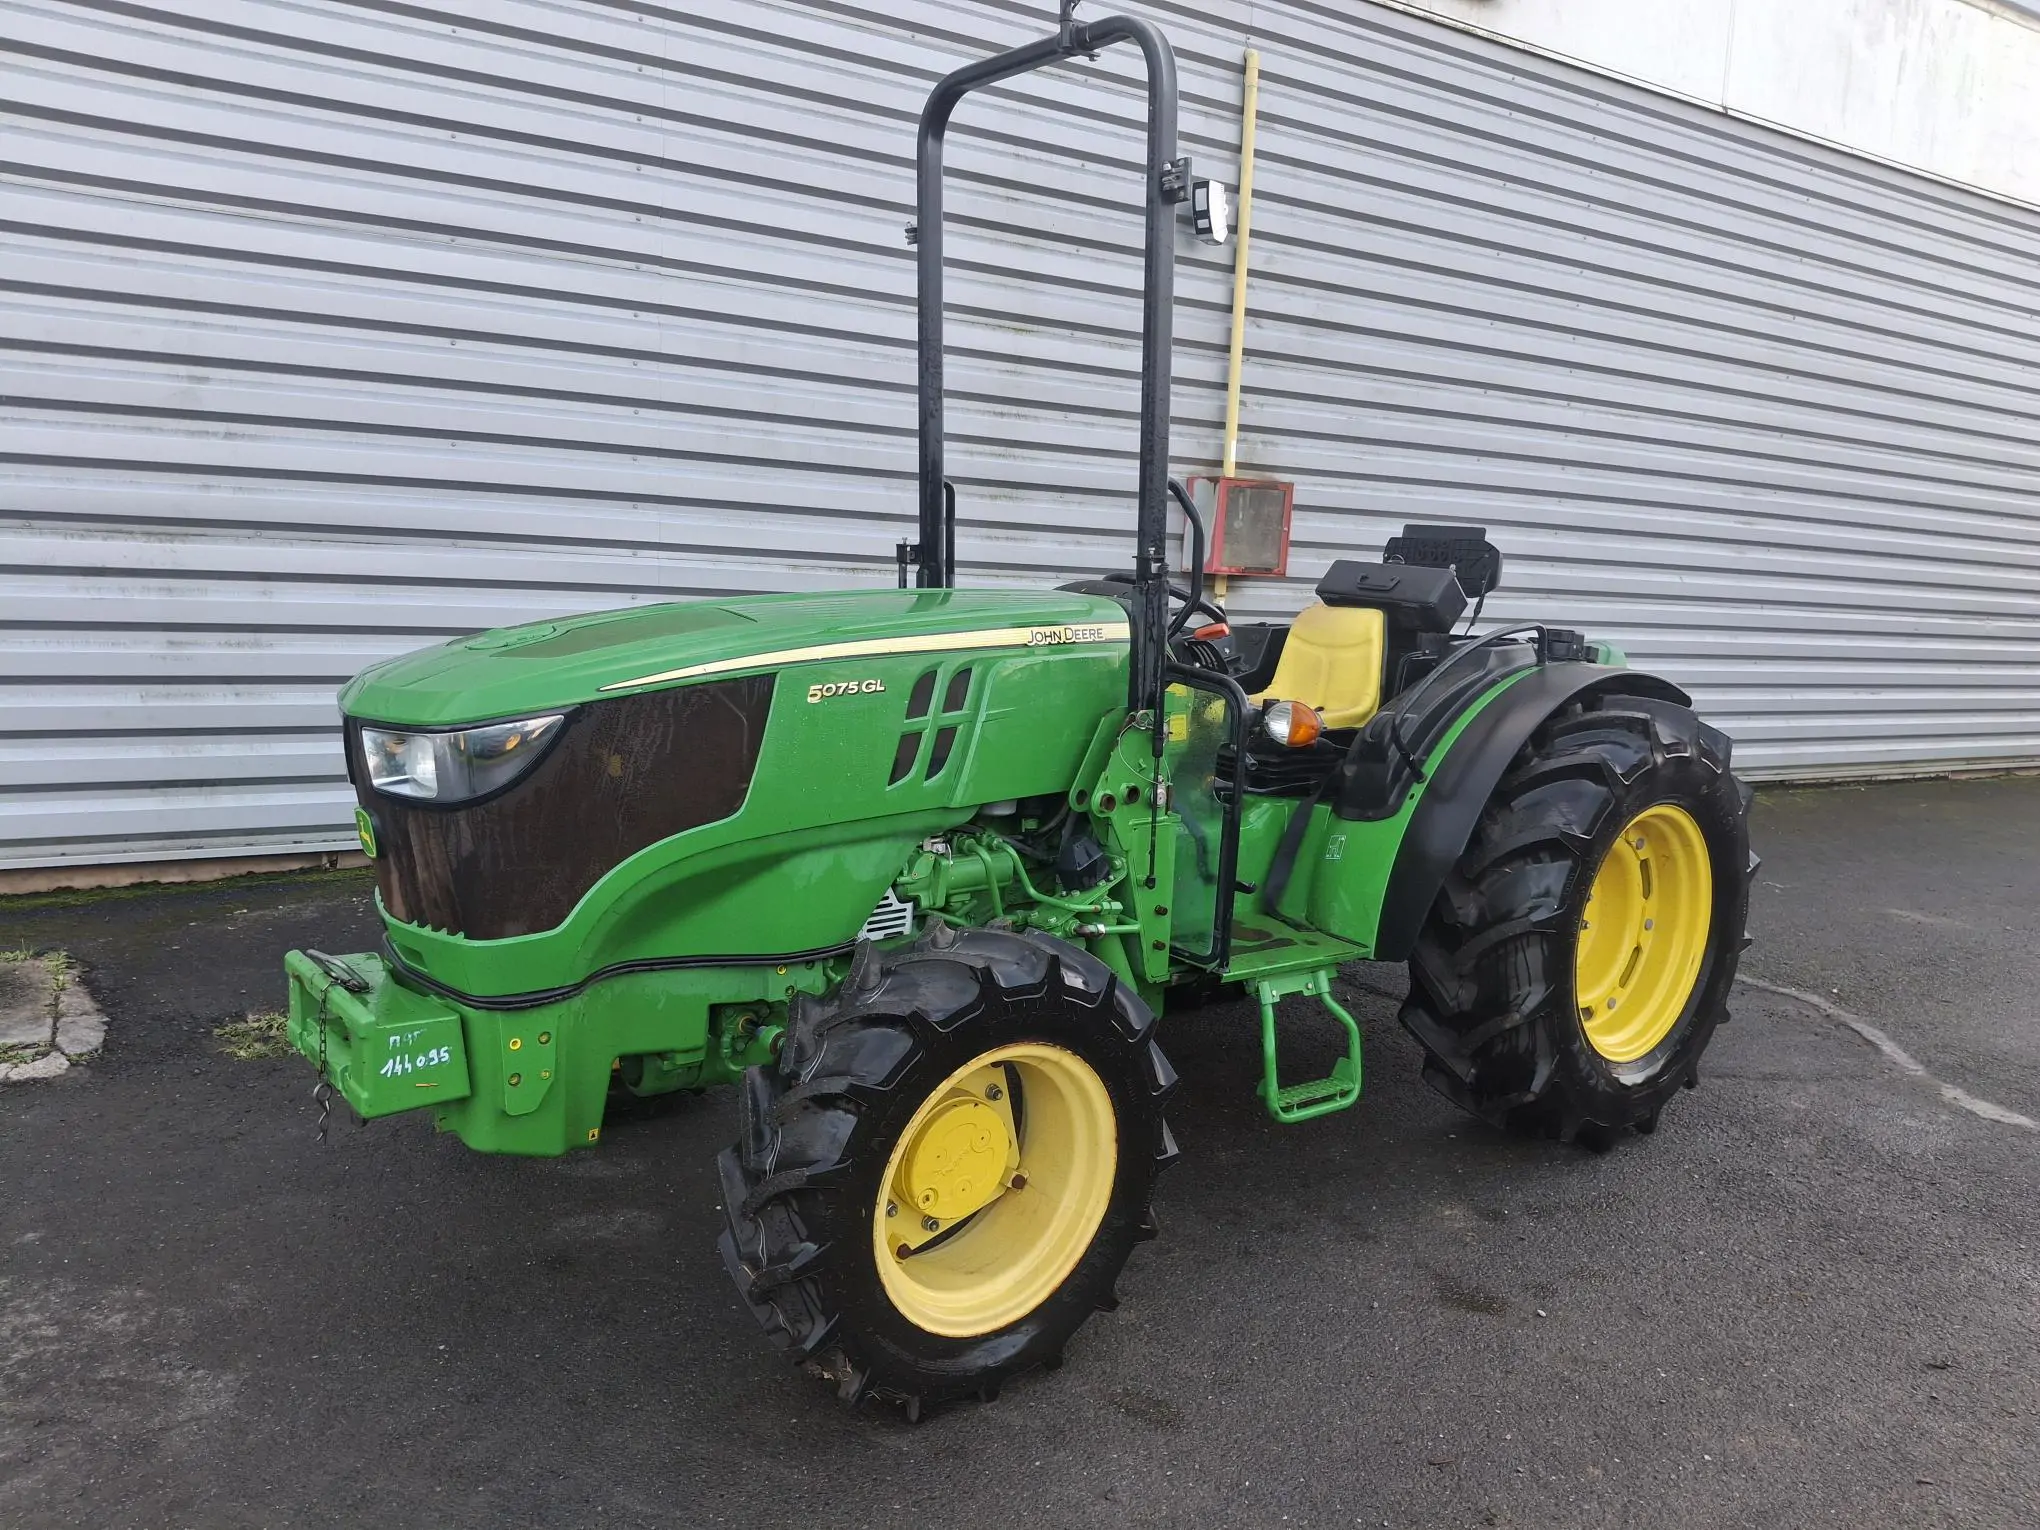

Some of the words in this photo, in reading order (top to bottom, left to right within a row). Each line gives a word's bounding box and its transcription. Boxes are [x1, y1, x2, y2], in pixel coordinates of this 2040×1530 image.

[1027, 629, 1062, 644] JOHN
[1063, 626, 1105, 641] DEERE
[807, 681, 860, 704] 5075
[861, 679, 886, 693] GL
